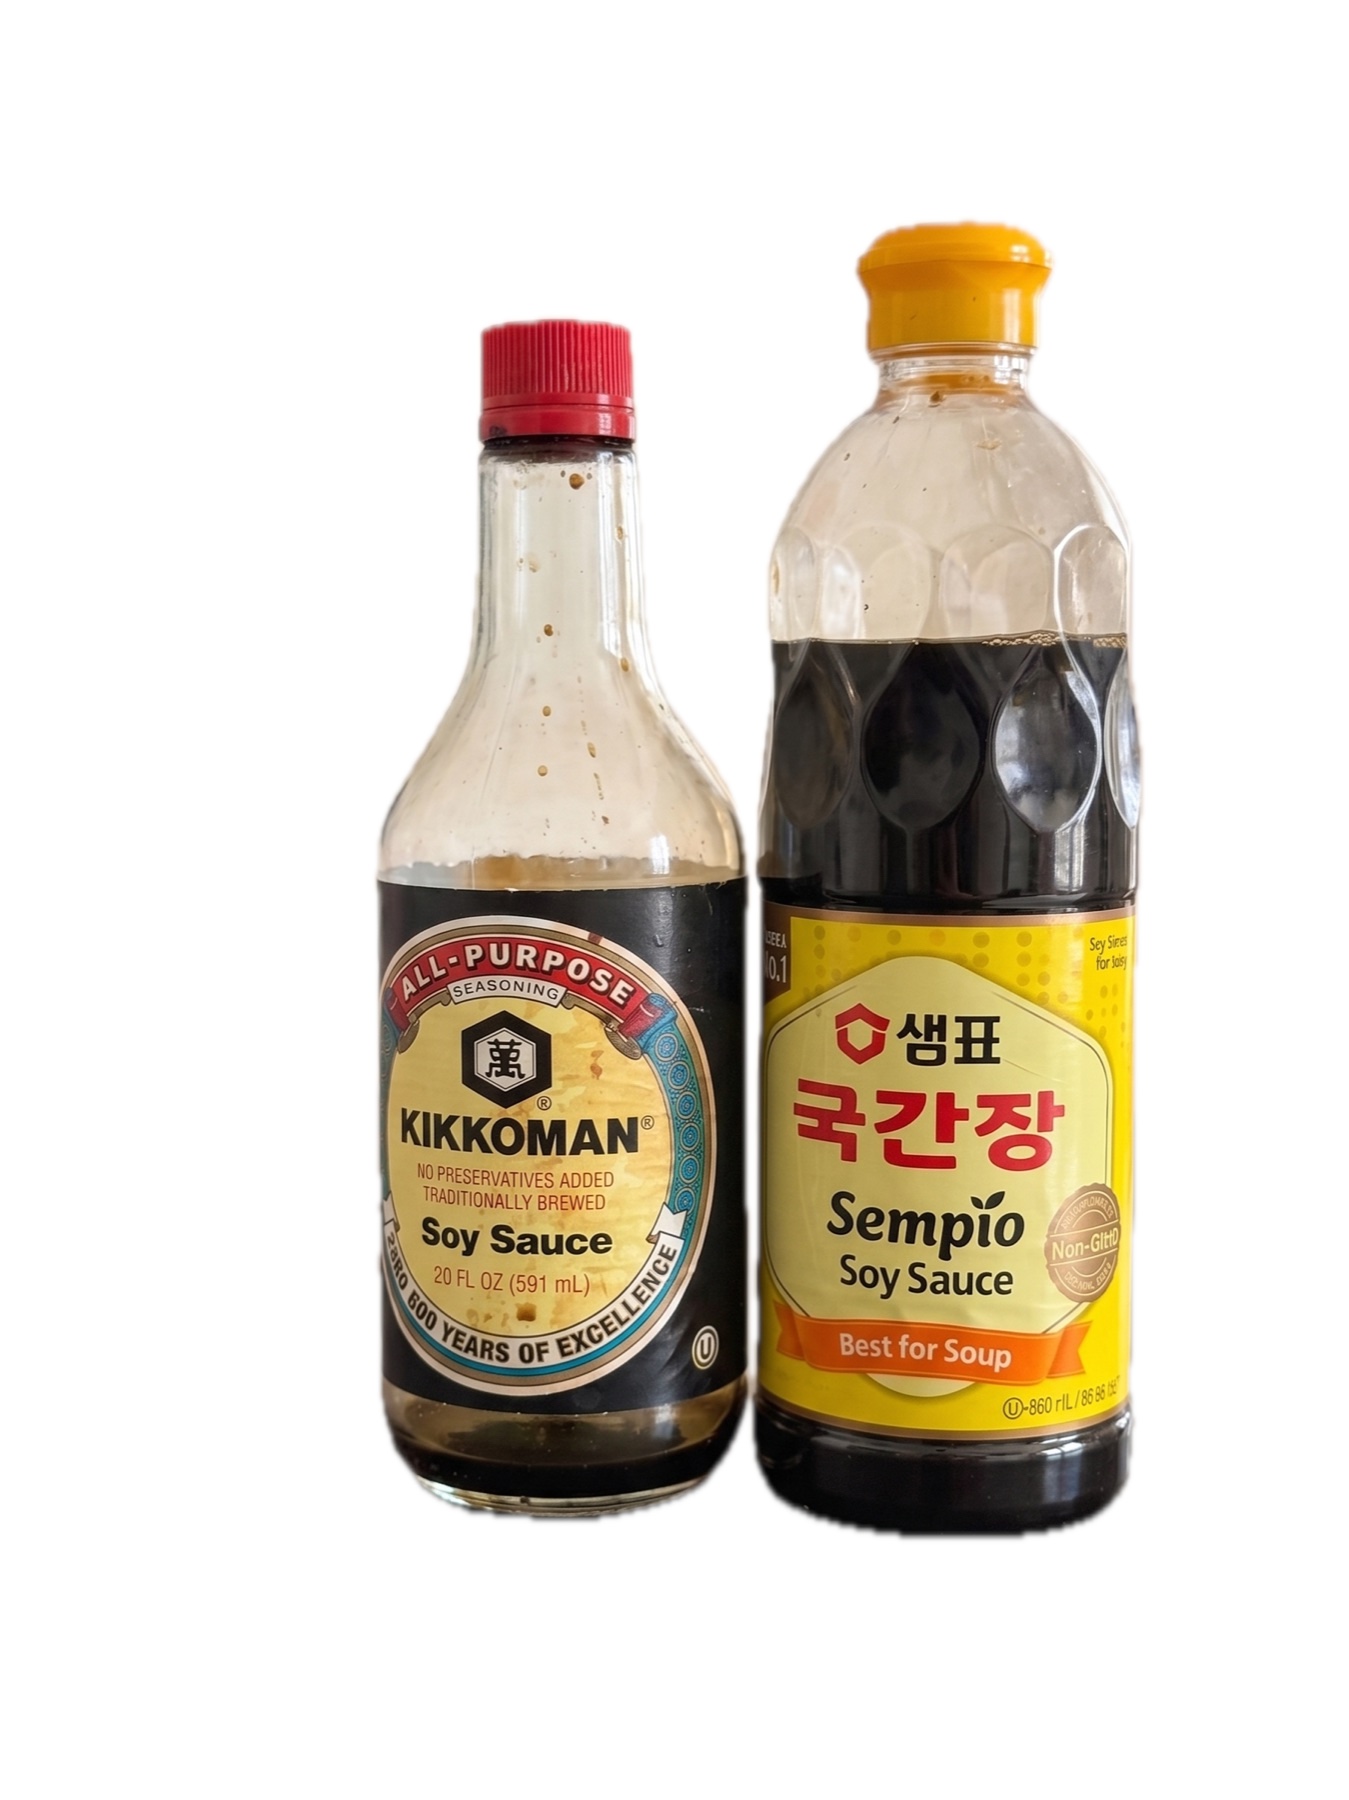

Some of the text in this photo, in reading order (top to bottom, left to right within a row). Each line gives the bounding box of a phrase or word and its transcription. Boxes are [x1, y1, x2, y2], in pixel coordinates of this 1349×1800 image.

[401, 942, 636, 1007] ALL-PURPOSE
[452, 979, 560, 1000] SEASONING
[896, 1013, 1001, 1067] 샘표
[793, 1077, 1066, 1172] 국간장
[417, 1162, 615, 1188] NO PRESERVATIVES ADDED
[423, 1185, 606, 1211] TRADITIONALLY BREWED
[421, 1216, 613, 1257] Soy Sauce
[826, 1190, 1025, 1261] Sempio
[433, 1265, 591, 1297] 20 FL OZ (591 mL)
[839, 1254, 1014, 1300] Soy Sauce
[441, 1321, 510, 1364] YEARS
[518, 1341, 549, 1364] OF
[556, 1243, 678, 1359] EXCELLENCE
[839, 1332, 1012, 1373] Best for Soup
